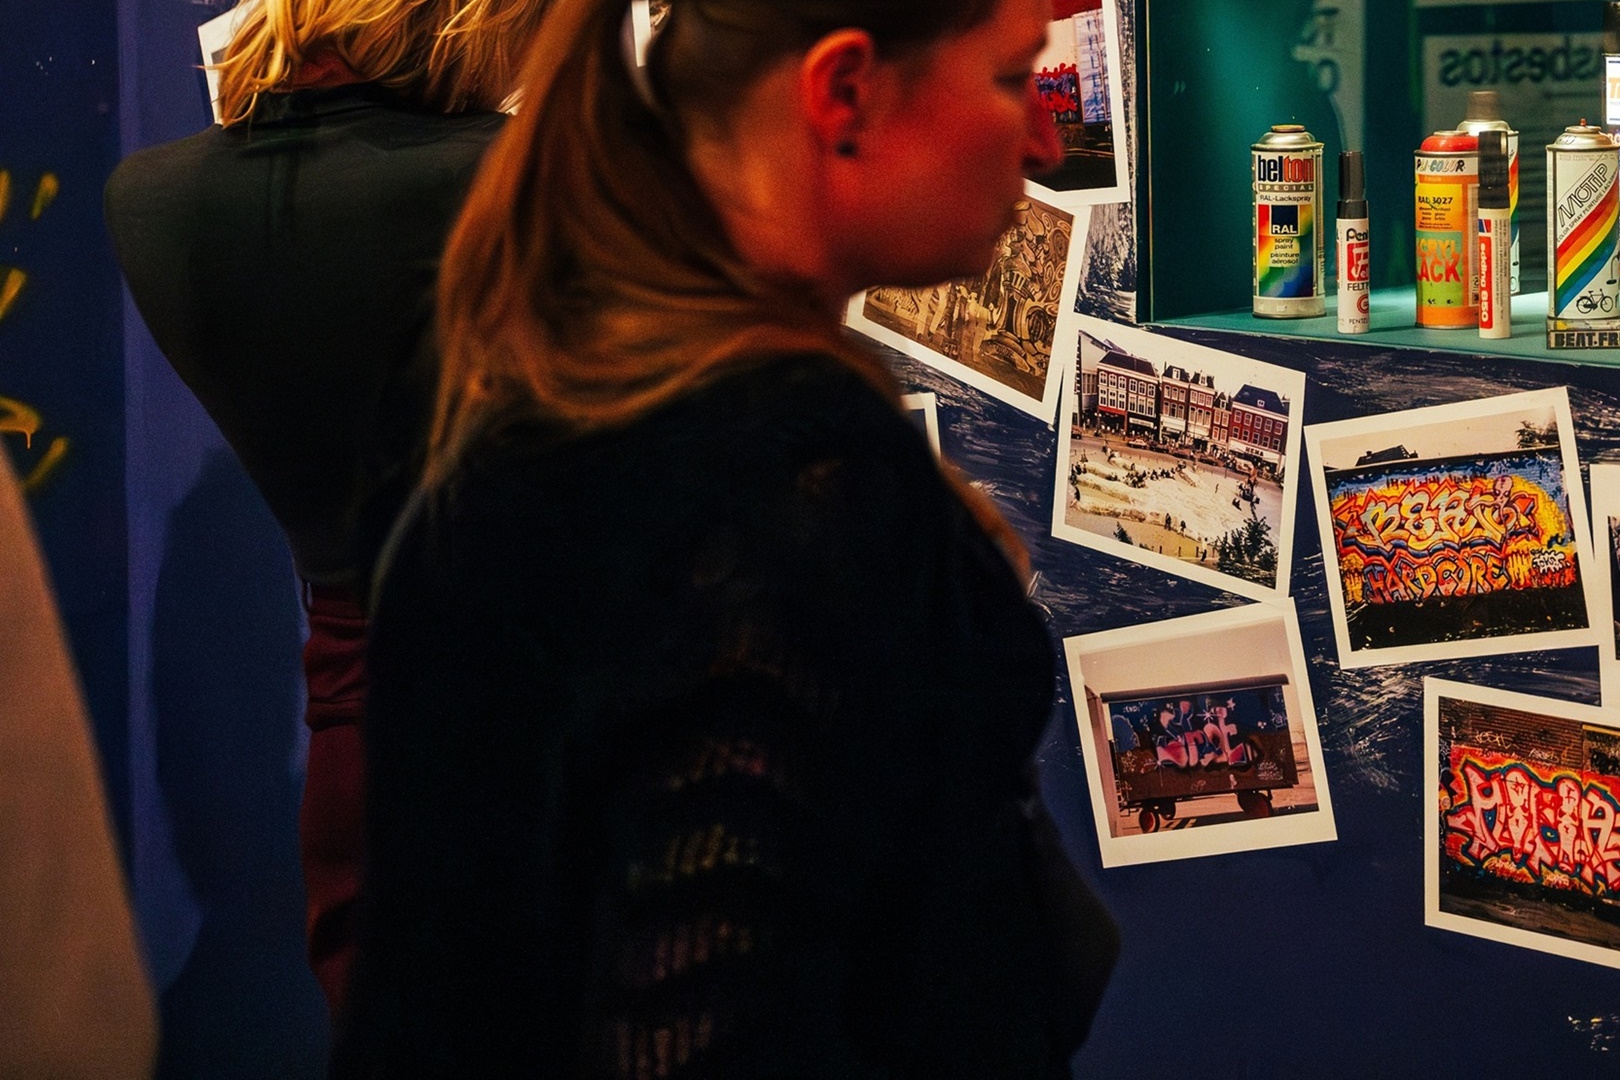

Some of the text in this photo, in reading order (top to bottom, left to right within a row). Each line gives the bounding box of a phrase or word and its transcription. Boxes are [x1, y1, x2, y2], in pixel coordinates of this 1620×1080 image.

[1258, 155, 1314, 183] belton
[1260, 195, 1311, 203] RAL-Lackspray
[1432, 196, 1454, 205] 3027
[1569, 213, 1584, 228] SPRAY
[1272, 224, 1298, 234] RAL
[1480, 242, 1489, 323] edding 850
[1245, 446, 1264, 457] HEMA
[1364, 554, 1509, 604] HARDCORE
